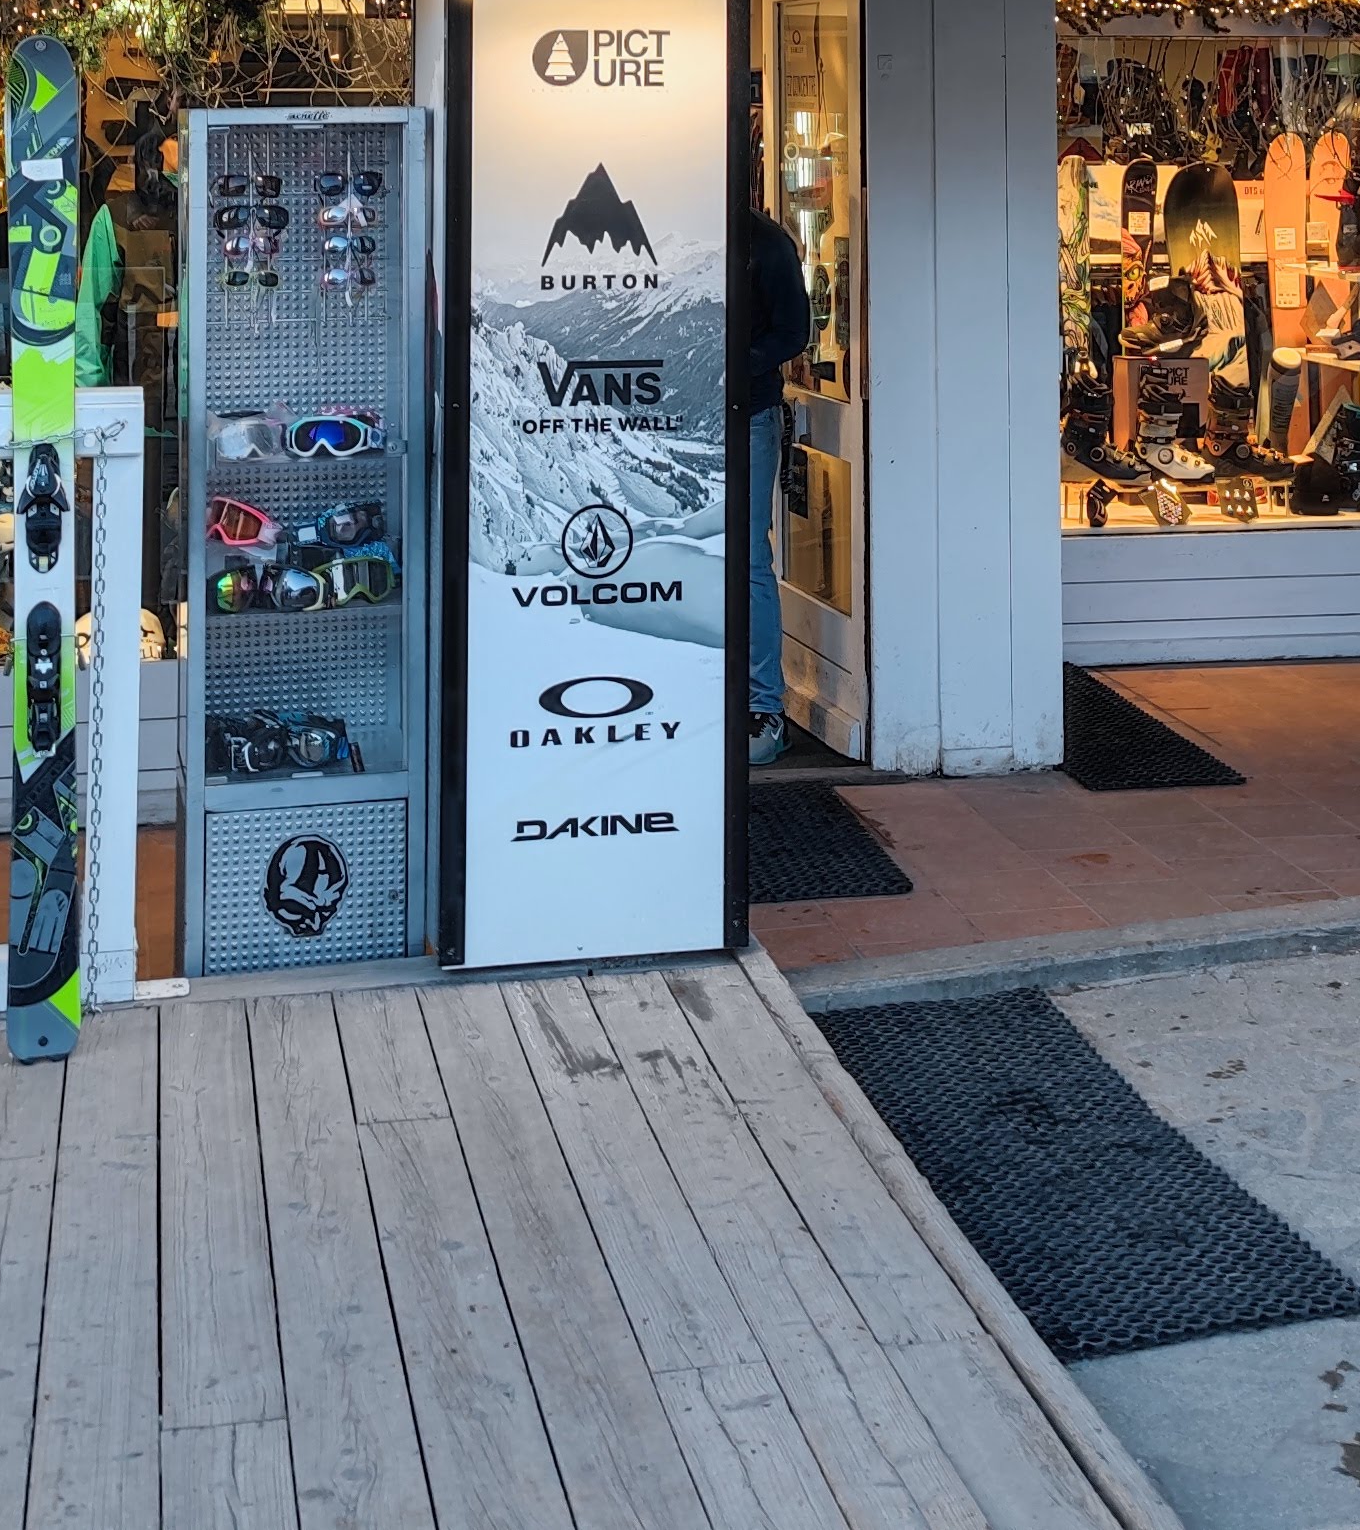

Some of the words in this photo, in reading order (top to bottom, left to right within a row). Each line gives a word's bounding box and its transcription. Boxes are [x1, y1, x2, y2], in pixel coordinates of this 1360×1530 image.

[592, 28, 671, 58] PICT
[592, 58, 666, 88] URE
[540, 273, 659, 291] BURTON
[537, 359, 664, 407] VANS
[513, 418, 568, 436] "OFF
[571, 417, 612, 435] THE
[618, 413, 684, 433] WALL"
[511, 580, 683, 608] VOLCOM
[509, 720, 682, 749] OAKLEY
[509, 810, 681, 843] DAKINE
